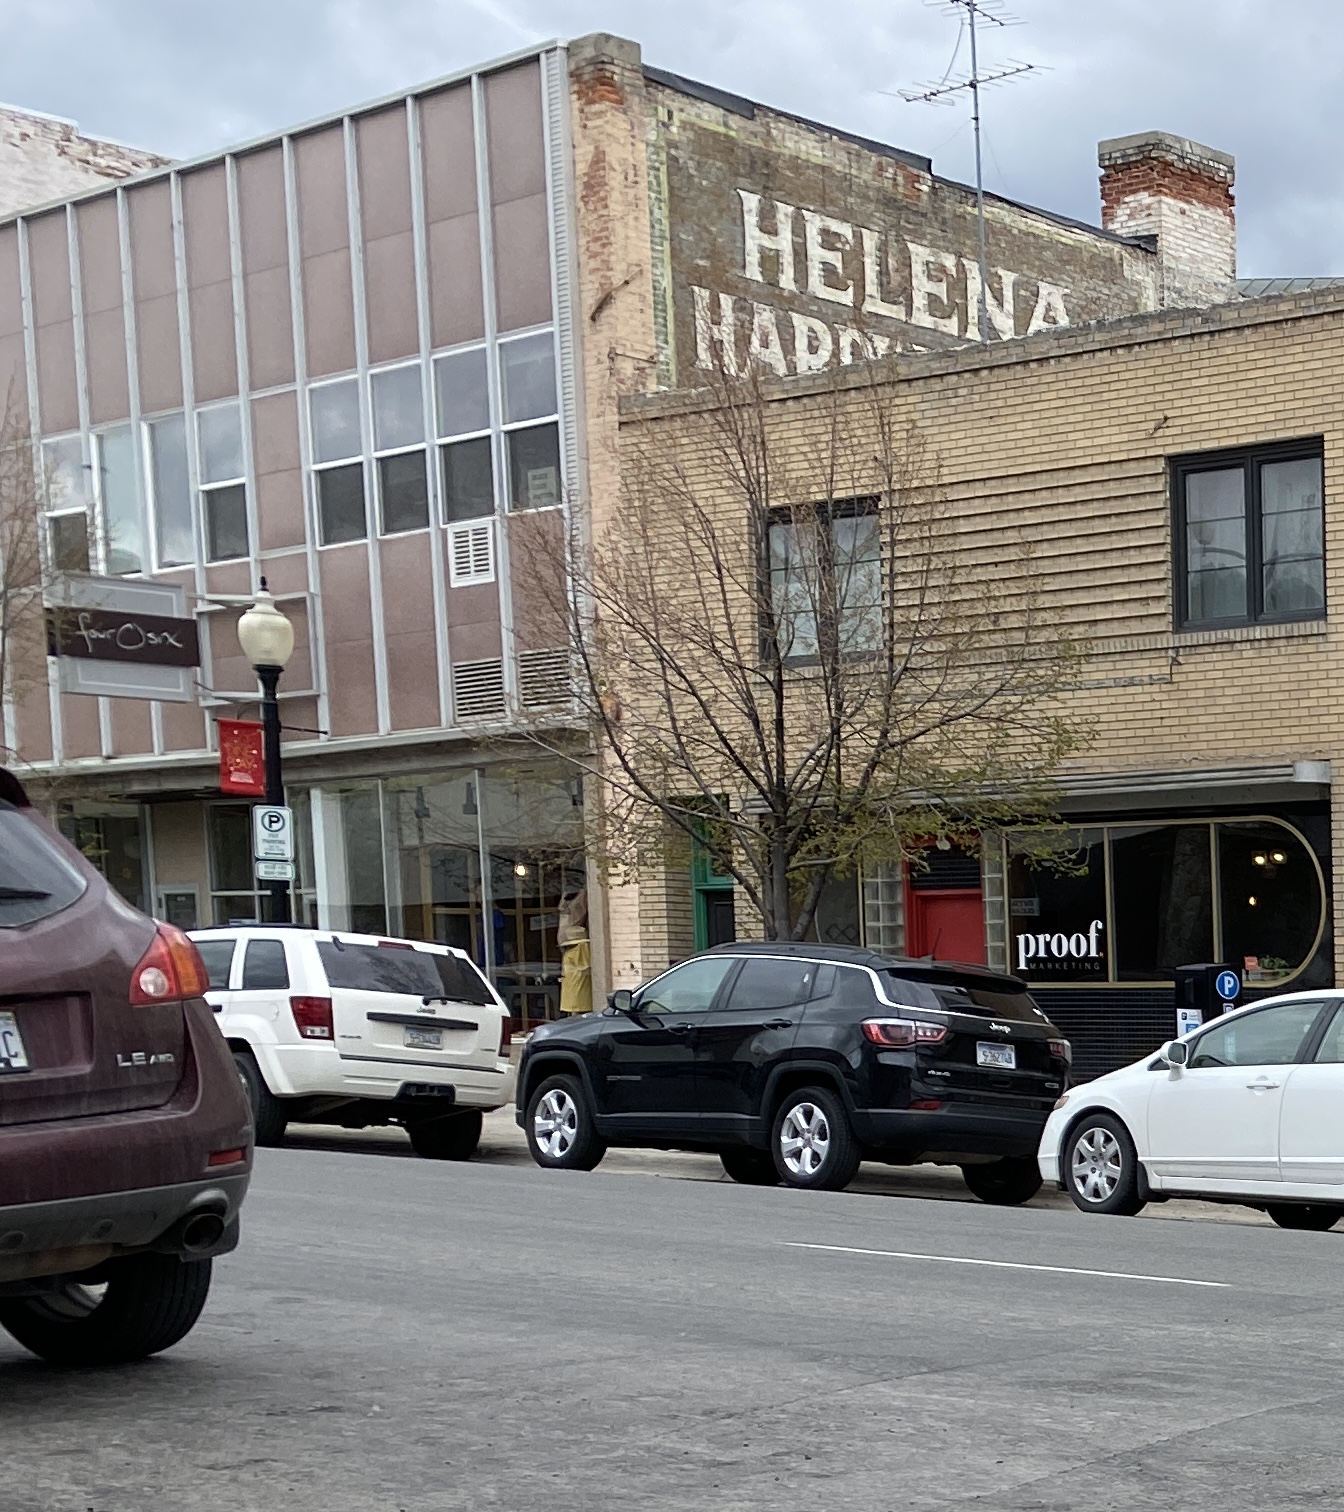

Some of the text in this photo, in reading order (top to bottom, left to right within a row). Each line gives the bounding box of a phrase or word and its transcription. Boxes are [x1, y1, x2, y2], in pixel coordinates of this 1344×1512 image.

[736, 189, 1070, 342] HELENA
[1029, 961, 1101, 970] MARKETING
[117, 1052, 147, 1067] LE
